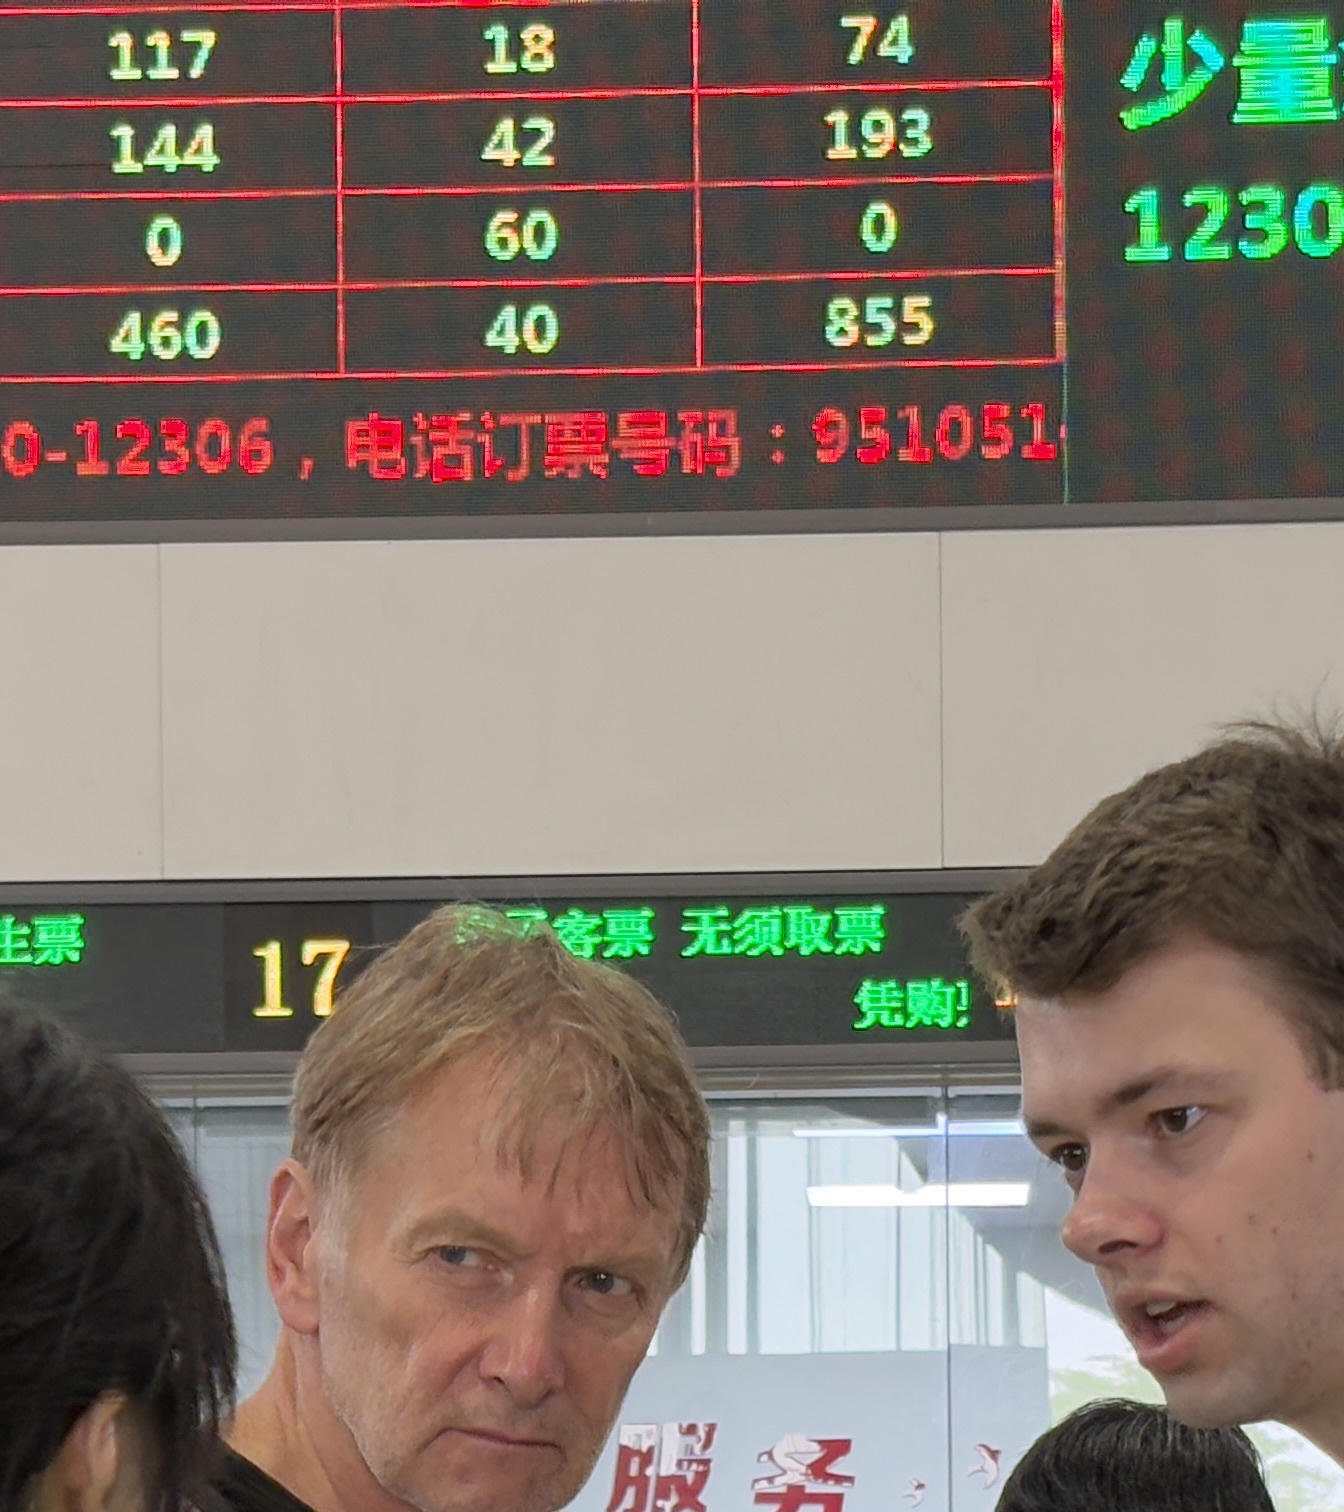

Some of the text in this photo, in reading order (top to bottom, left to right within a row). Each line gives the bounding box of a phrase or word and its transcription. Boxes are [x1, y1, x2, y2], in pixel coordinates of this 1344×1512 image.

[109, 30, 215, 79] 117
[484, 24, 554, 73] 18
[841, 15, 913, 64] 74
[110, 124, 220, 173] 144
[481, 117, 554, 166] 42
[824, 108, 932, 158] 193
[146, 217, 182, 266] 0
[485, 210, 558, 260] 60
[861, 203, 897, 252] 0
[110, 310, 220, 359] 460
[486, 305, 558, 353] 40
[825, 296, 934, 346] 855
[456, 904, 886, 958] 客票 无须取票
[255, 940, 349, 1018] 17
[854, 978, 969, 1028] 凭购
